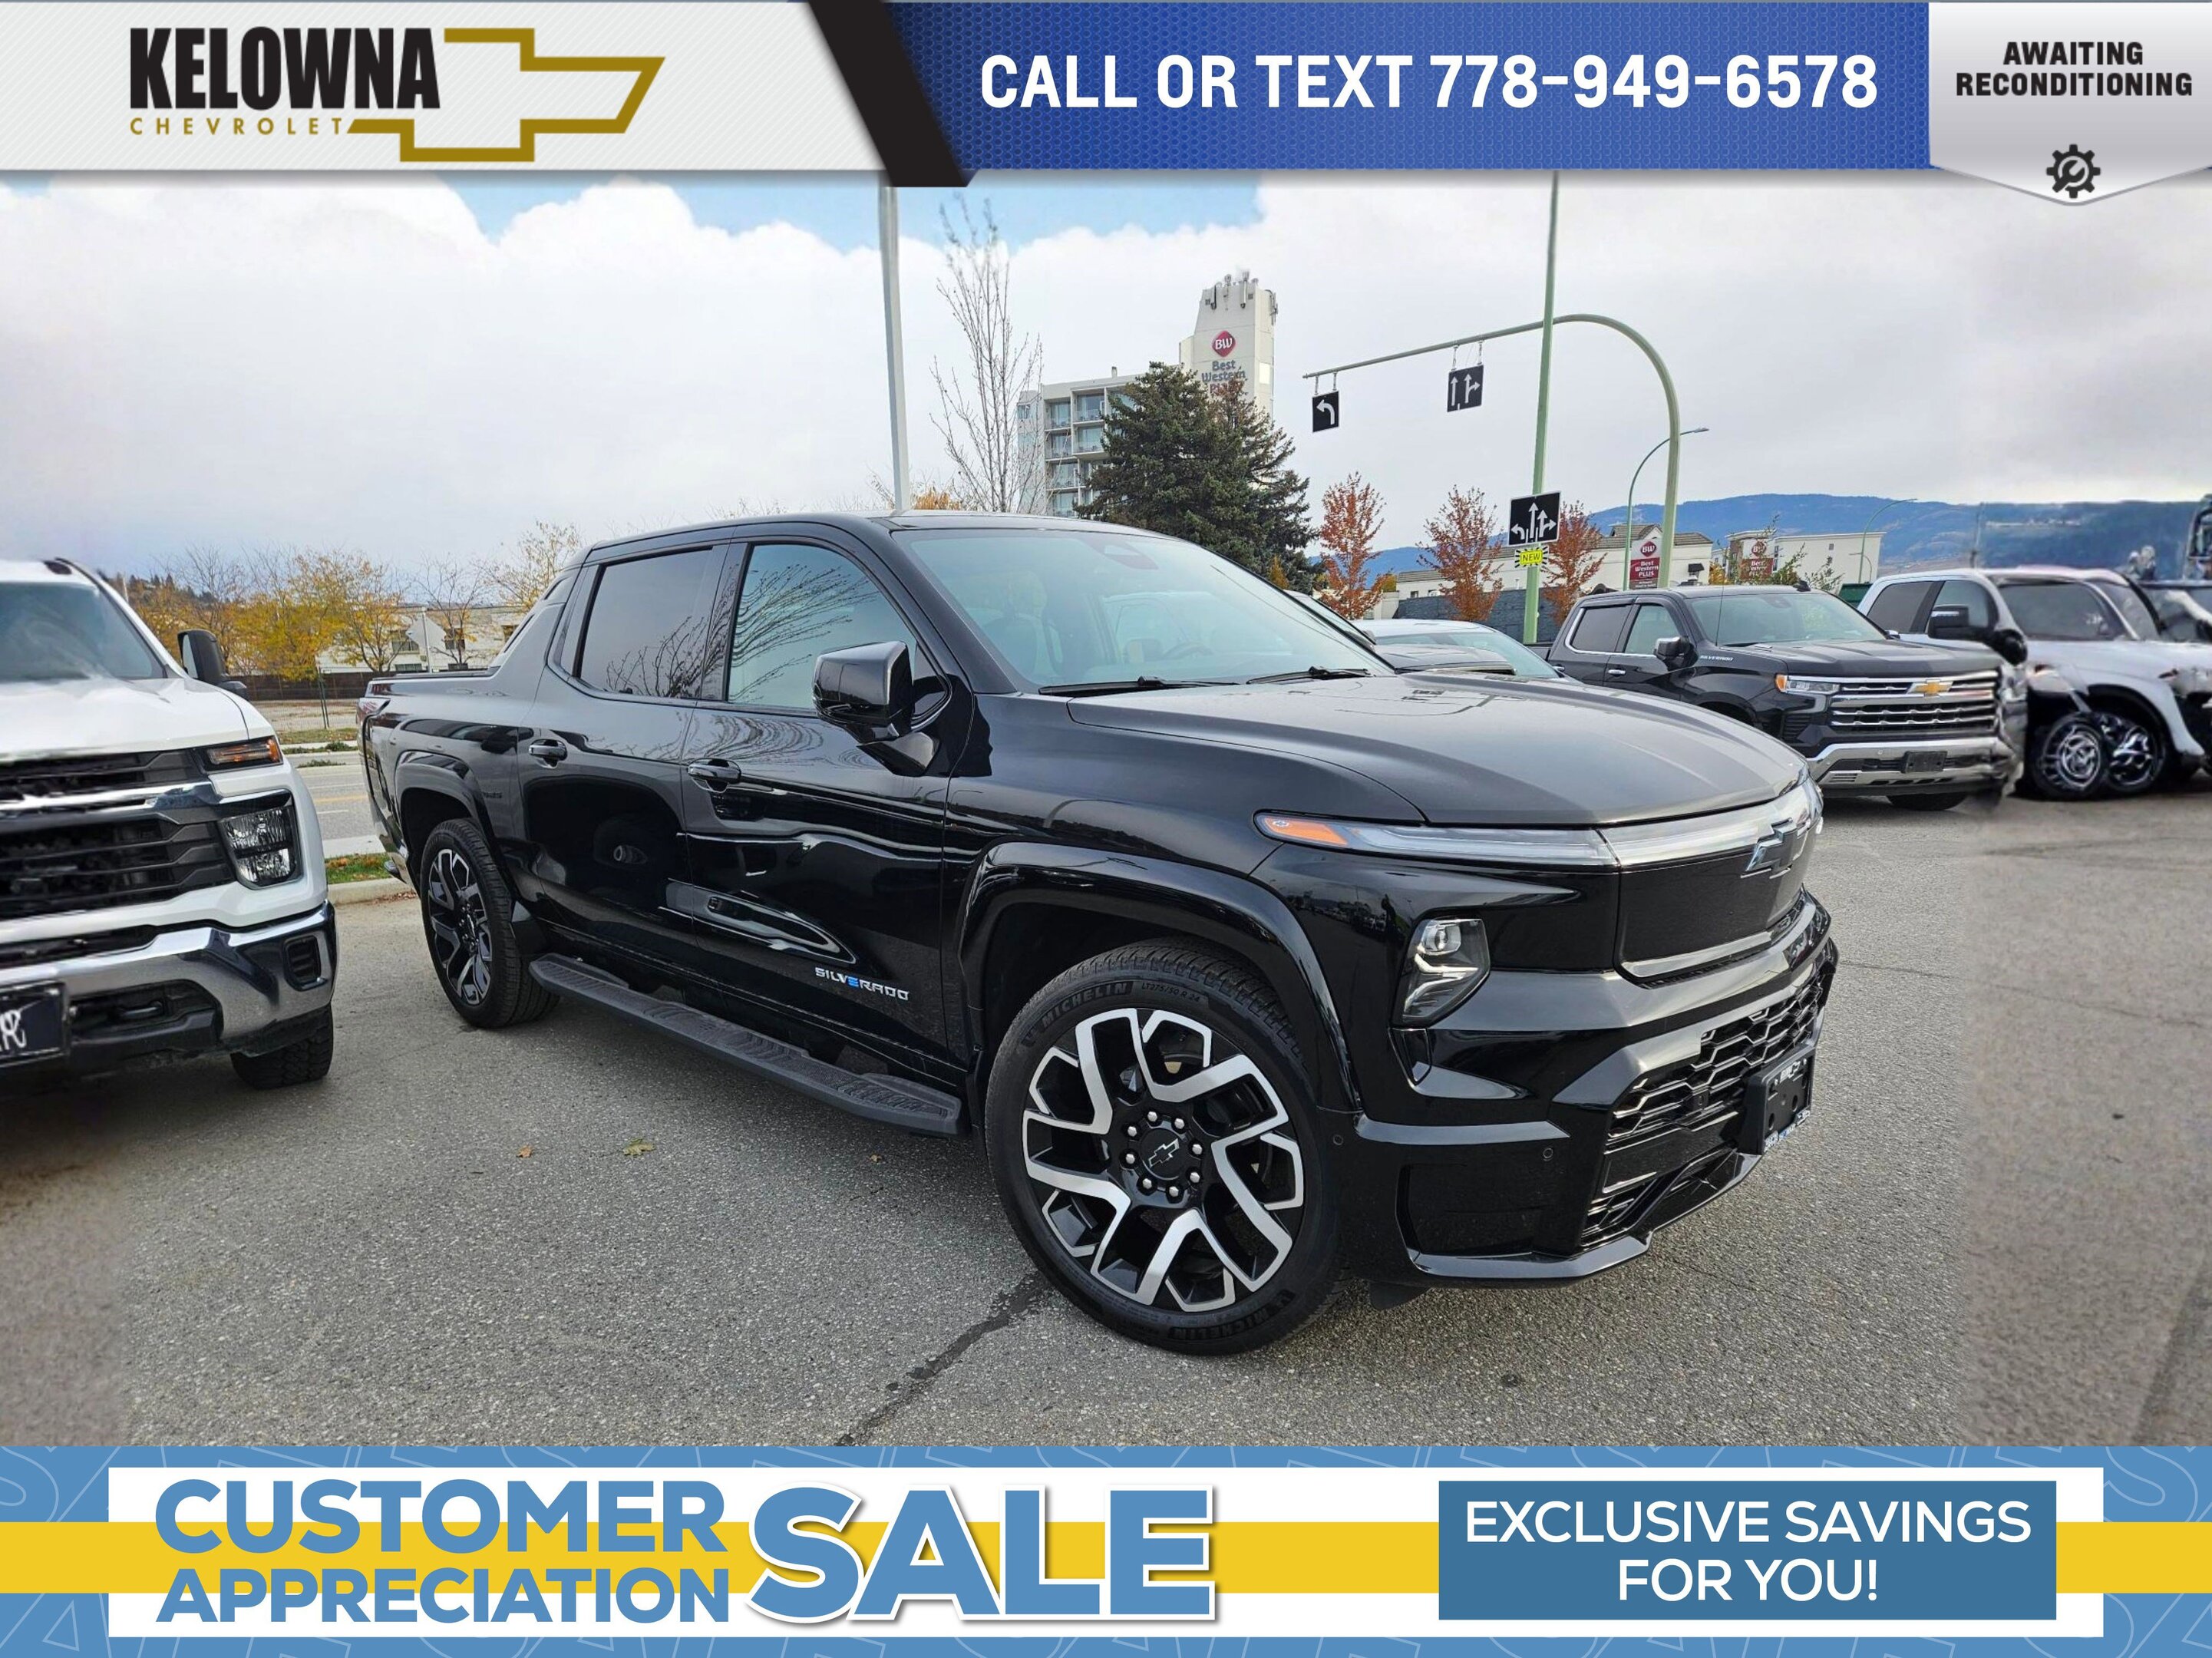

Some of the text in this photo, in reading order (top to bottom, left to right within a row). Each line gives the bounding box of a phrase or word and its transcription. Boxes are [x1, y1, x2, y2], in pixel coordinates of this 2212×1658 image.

[1215, 338, 1233, 350] BW
[1212, 360, 1236, 371] Best
[1523, 553, 1540, 562] NEW
[814, 966, 910, 1001] SILVERADO
[1042, 982, 1127, 1028] MICHELIN
